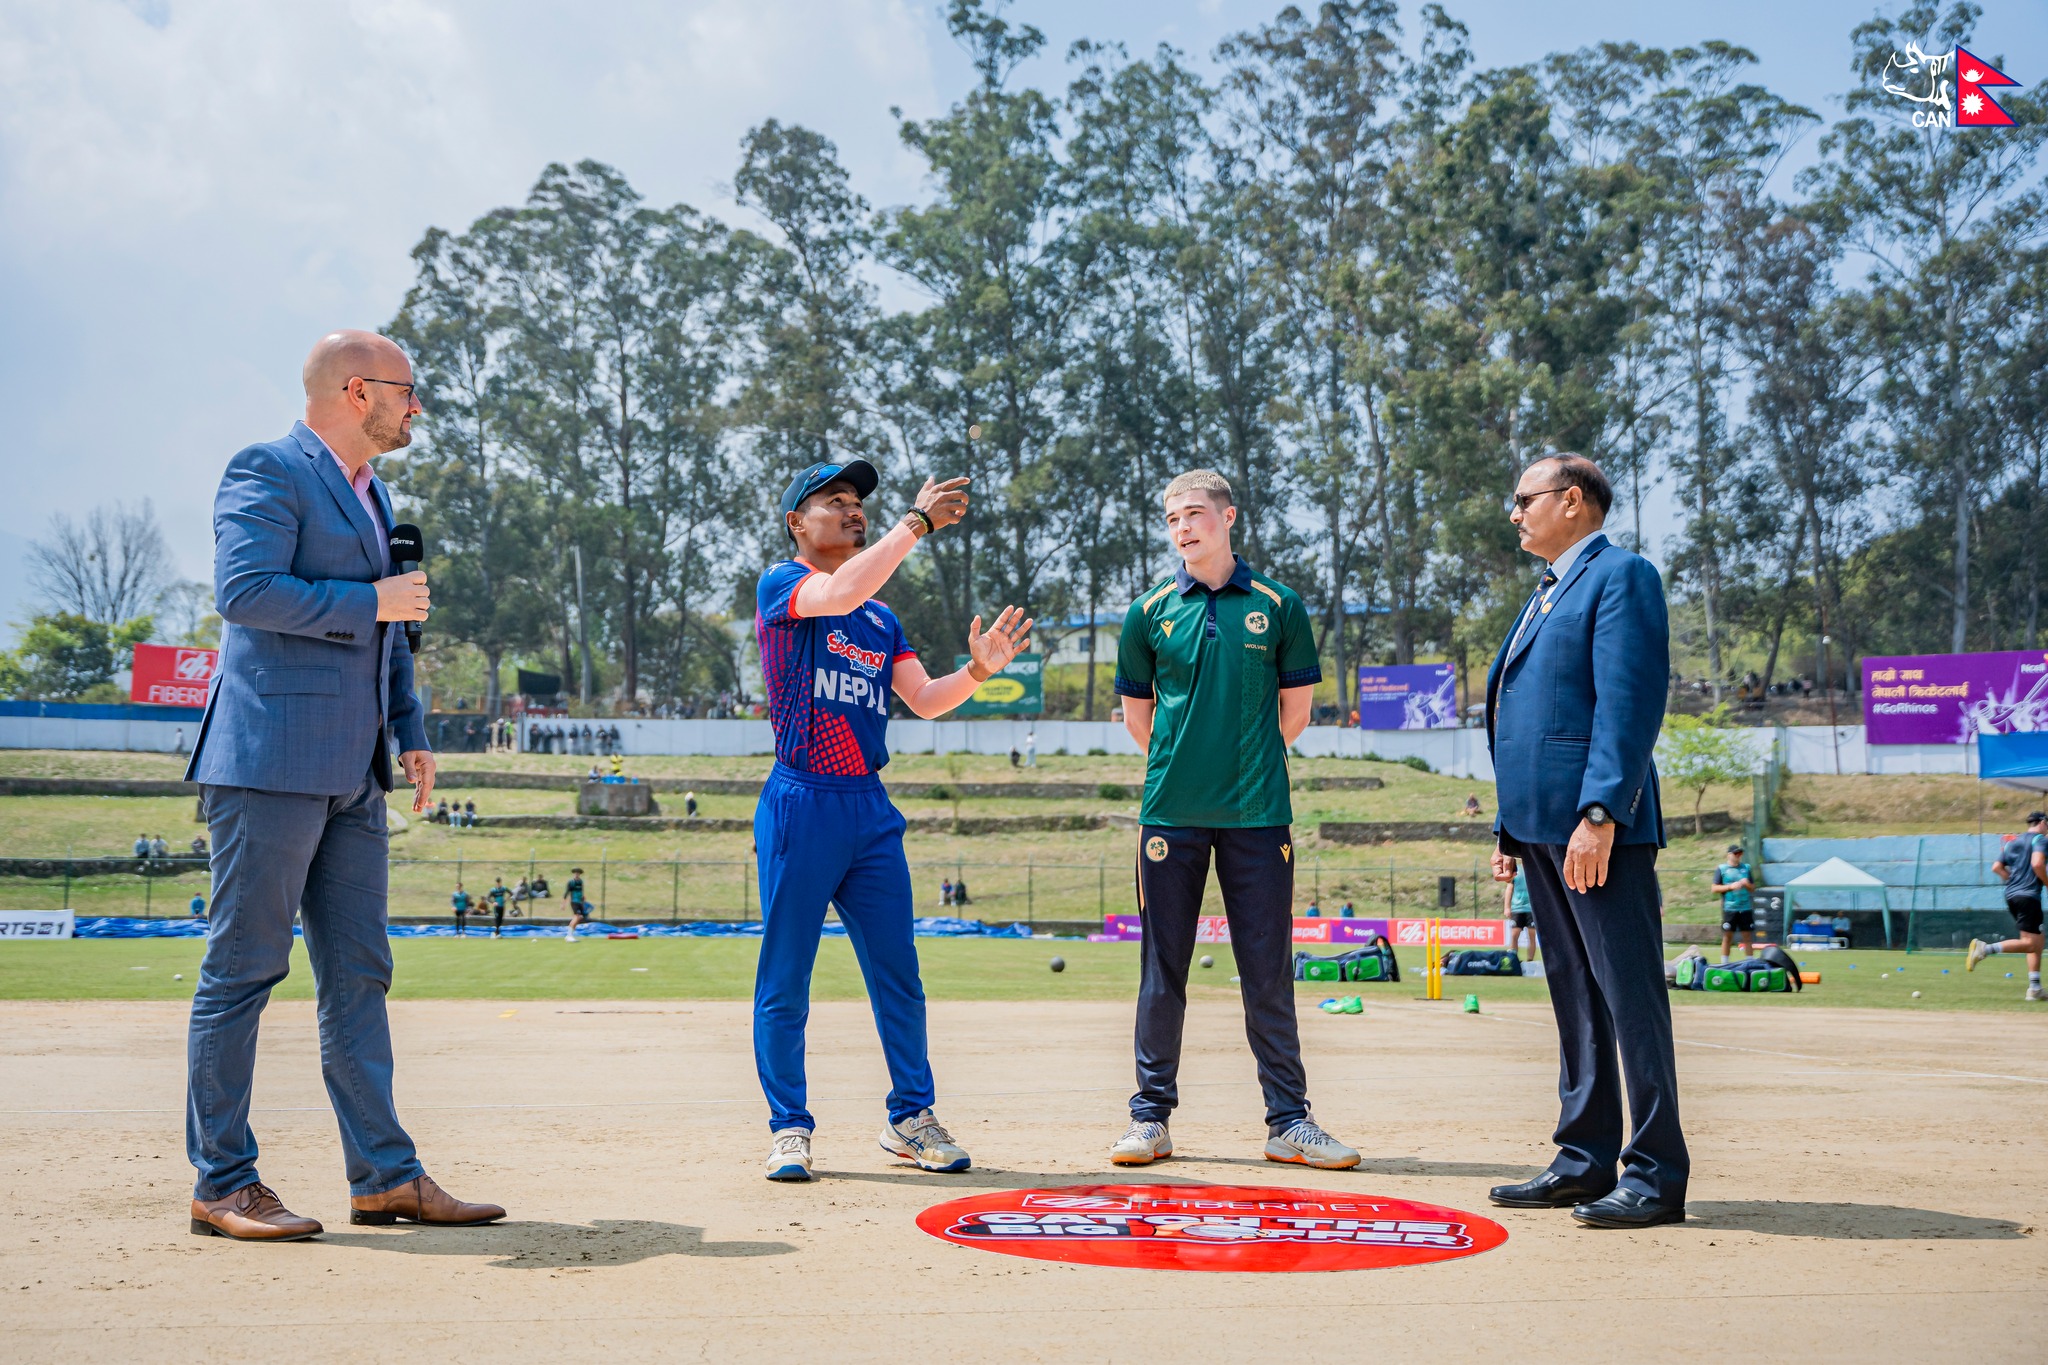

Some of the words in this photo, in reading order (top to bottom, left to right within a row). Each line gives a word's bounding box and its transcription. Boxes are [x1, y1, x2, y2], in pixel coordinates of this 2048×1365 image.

[827, 633, 886, 671] Second
[1244, 643, 1267, 651] WOLVES
[814, 668, 887, 715] NEPAL
[1872, 702, 1939, 715] #GoRhinos
[979, 1213, 1261, 1228] CATCH
[1277, 1217, 1451, 1233] THE
[988, 1223, 1120, 1236] BIG
